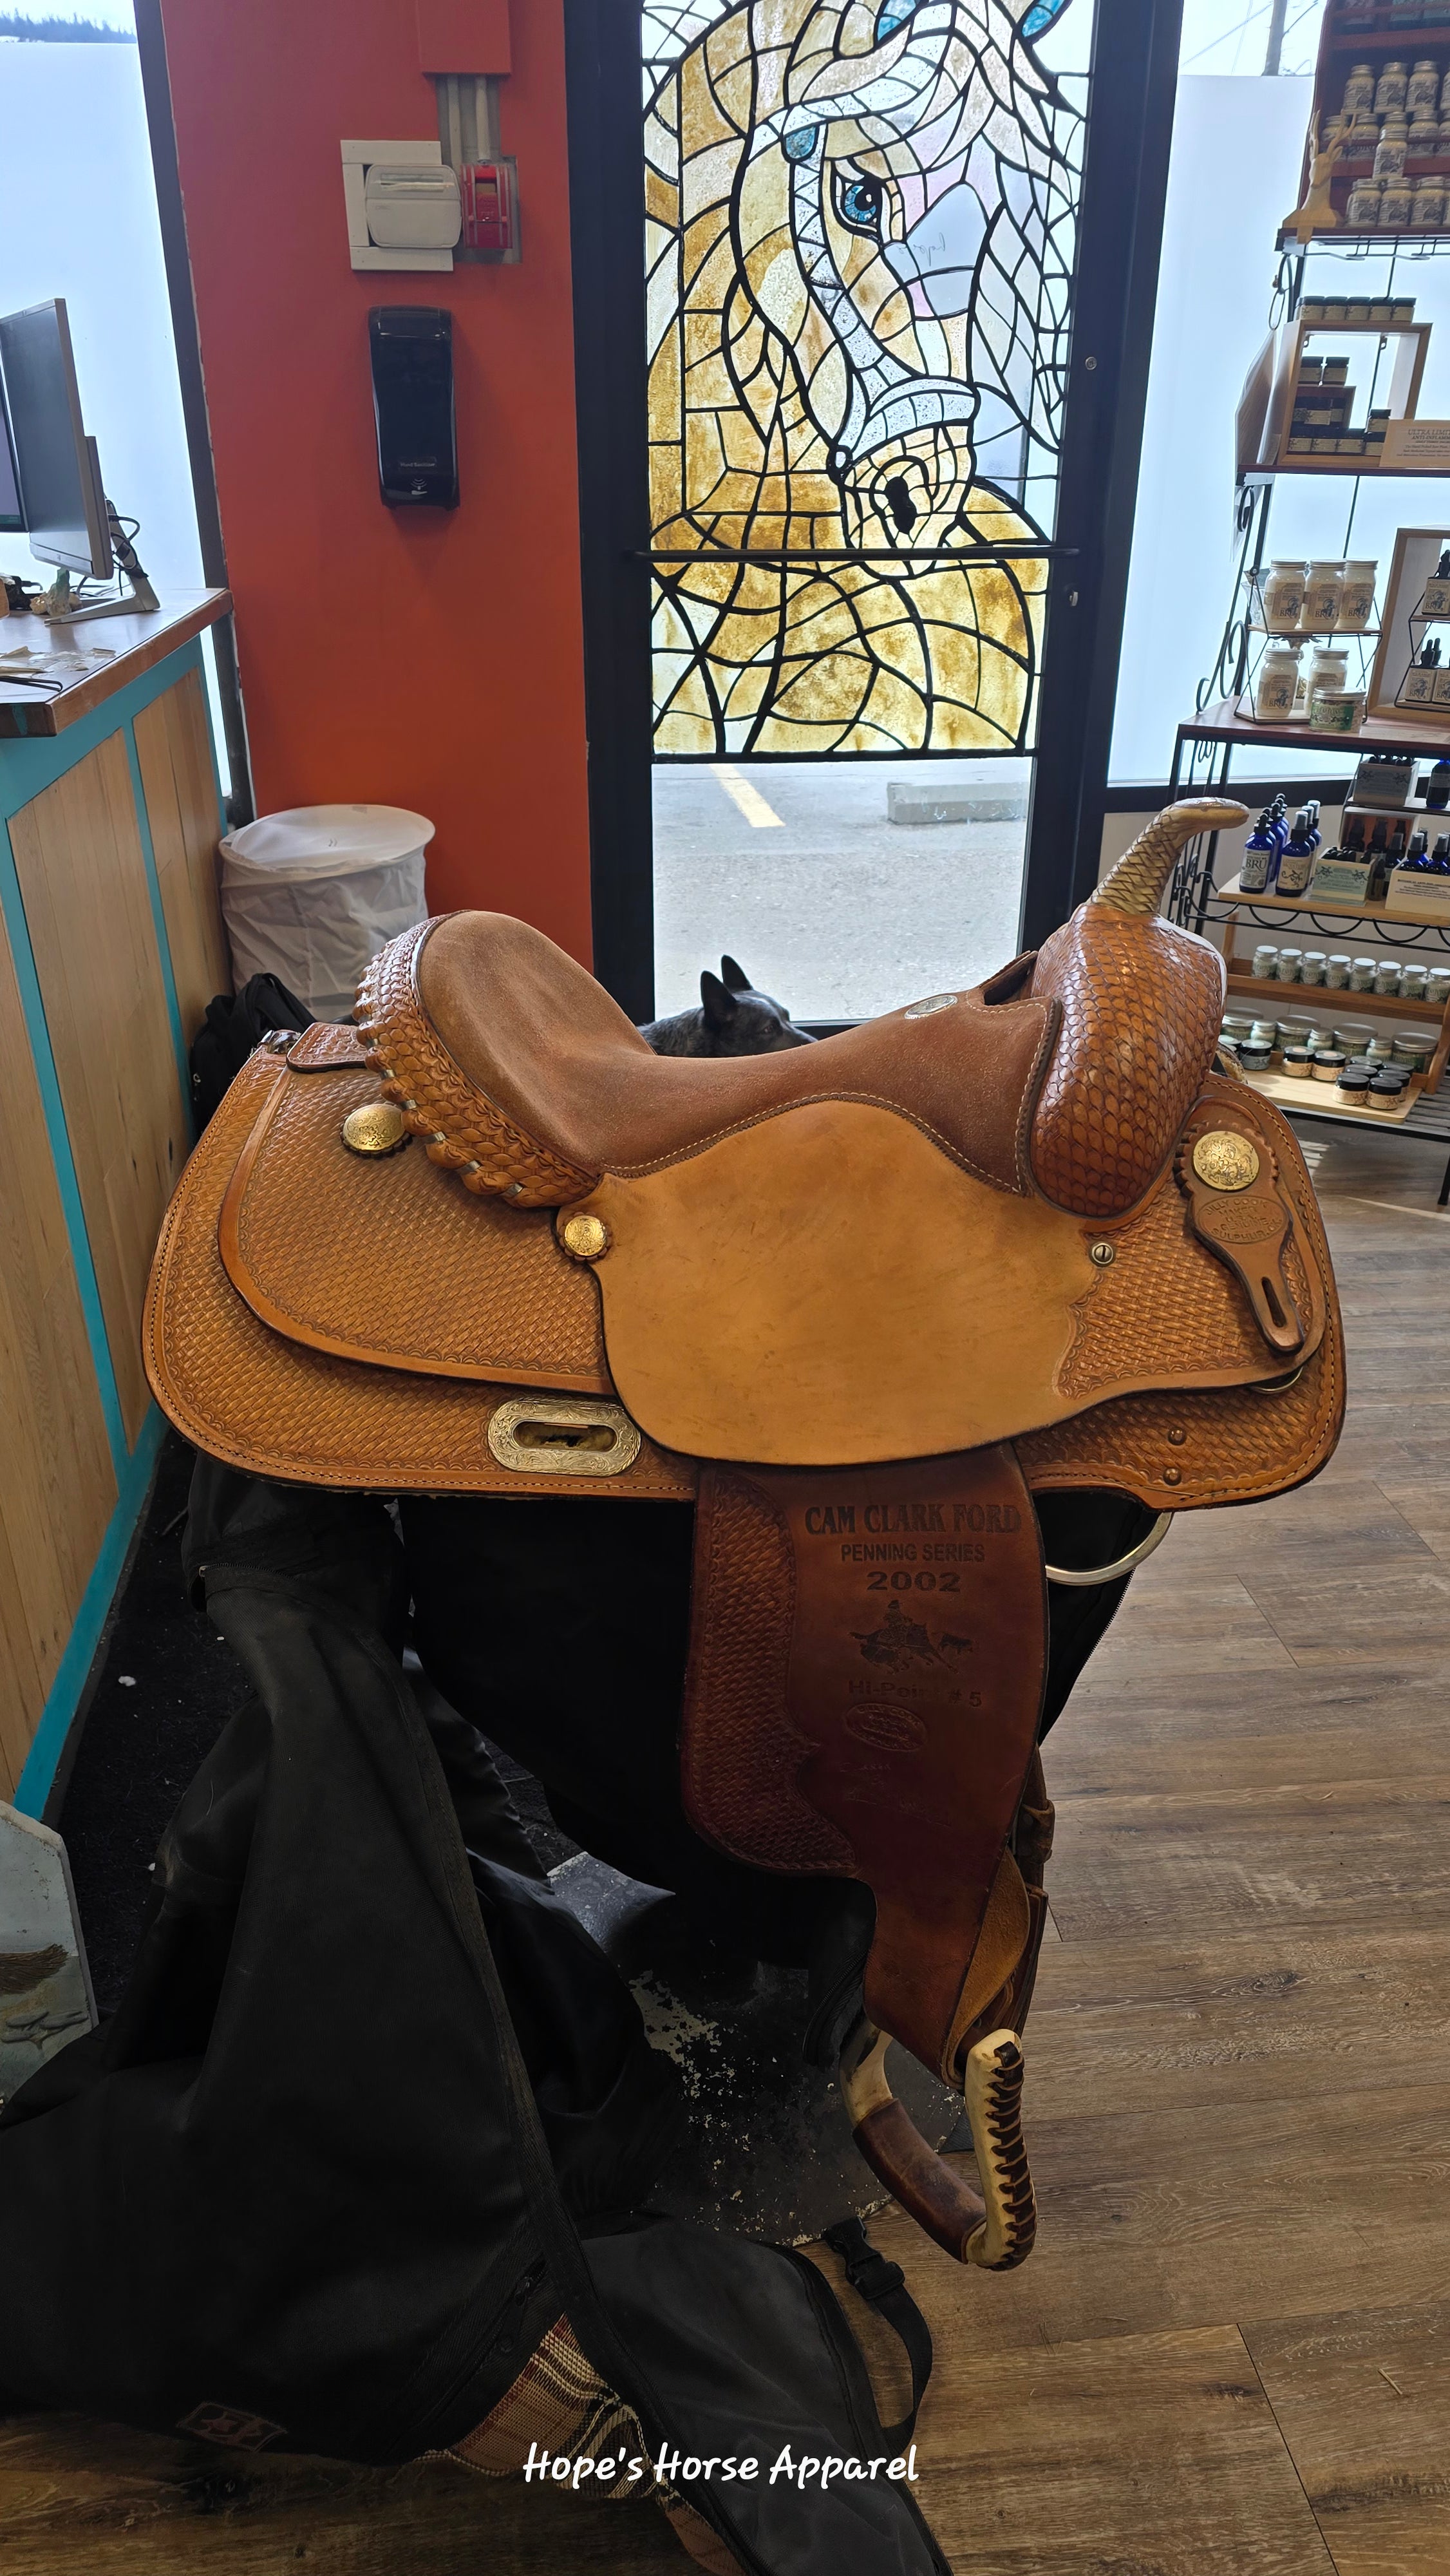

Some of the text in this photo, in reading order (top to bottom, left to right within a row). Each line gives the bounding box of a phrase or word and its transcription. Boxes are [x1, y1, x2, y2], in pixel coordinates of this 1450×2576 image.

[1246, 857, 1267, 871] BRÜ
[1234, 1198, 1267, 1208] COOK
[1219, 1206, 1257, 1217] MAKER
[1220, 1217, 1269, 1231] GENUINE
[805, 1504, 1022, 1535] CAM CLARK FORD
[841, 1544, 985, 1563] PENNING SERIES
[867, 1571, 961, 1593] 2002
